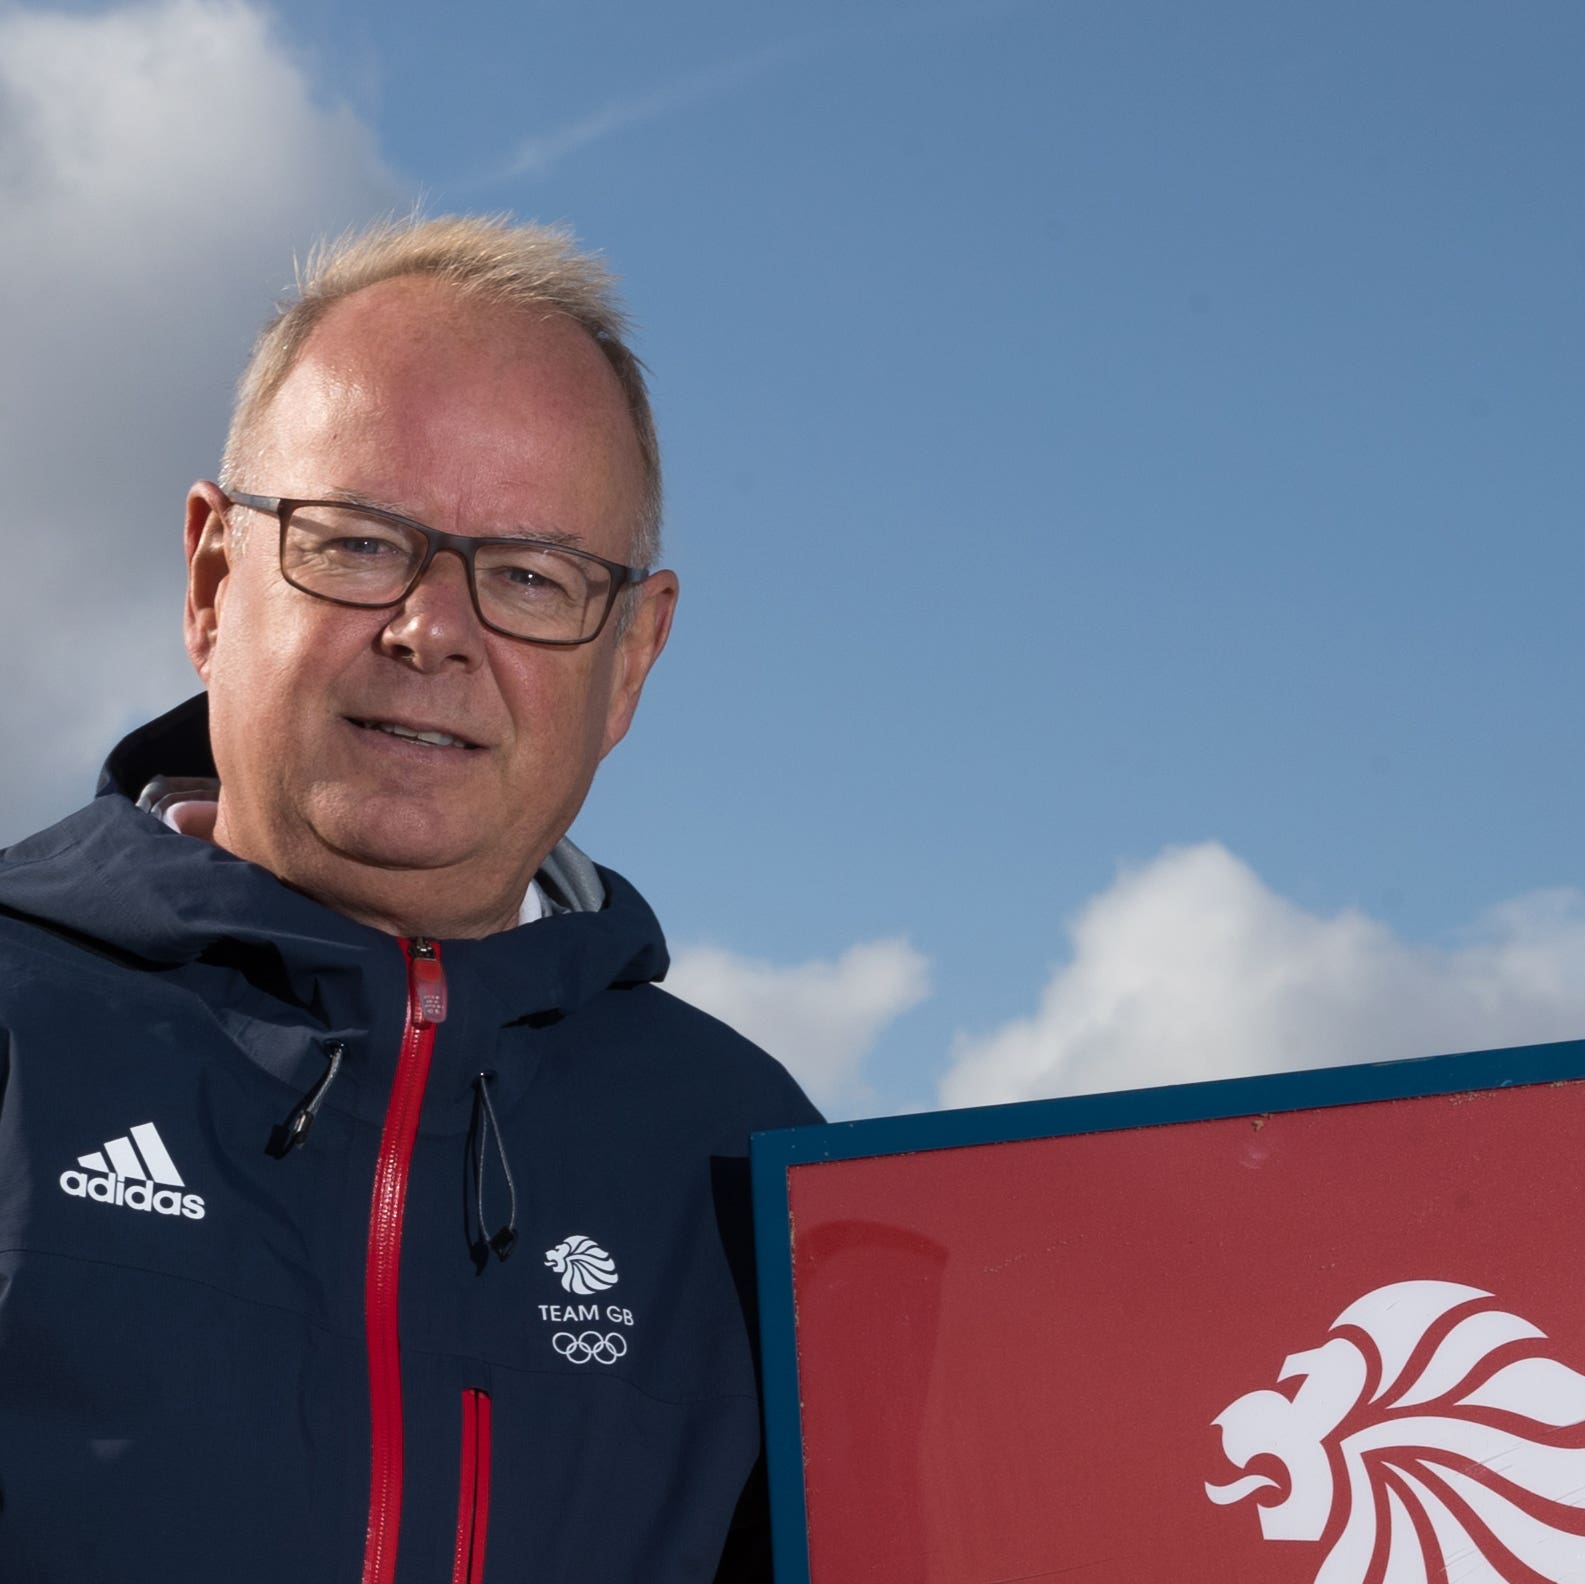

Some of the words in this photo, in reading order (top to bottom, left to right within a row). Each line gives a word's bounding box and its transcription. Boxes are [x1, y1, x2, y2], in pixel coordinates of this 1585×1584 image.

[59, 1170, 206, 1220] adidas
[537, 1304, 600, 1322] TEAM
[606, 1305, 634, 1326] GB
